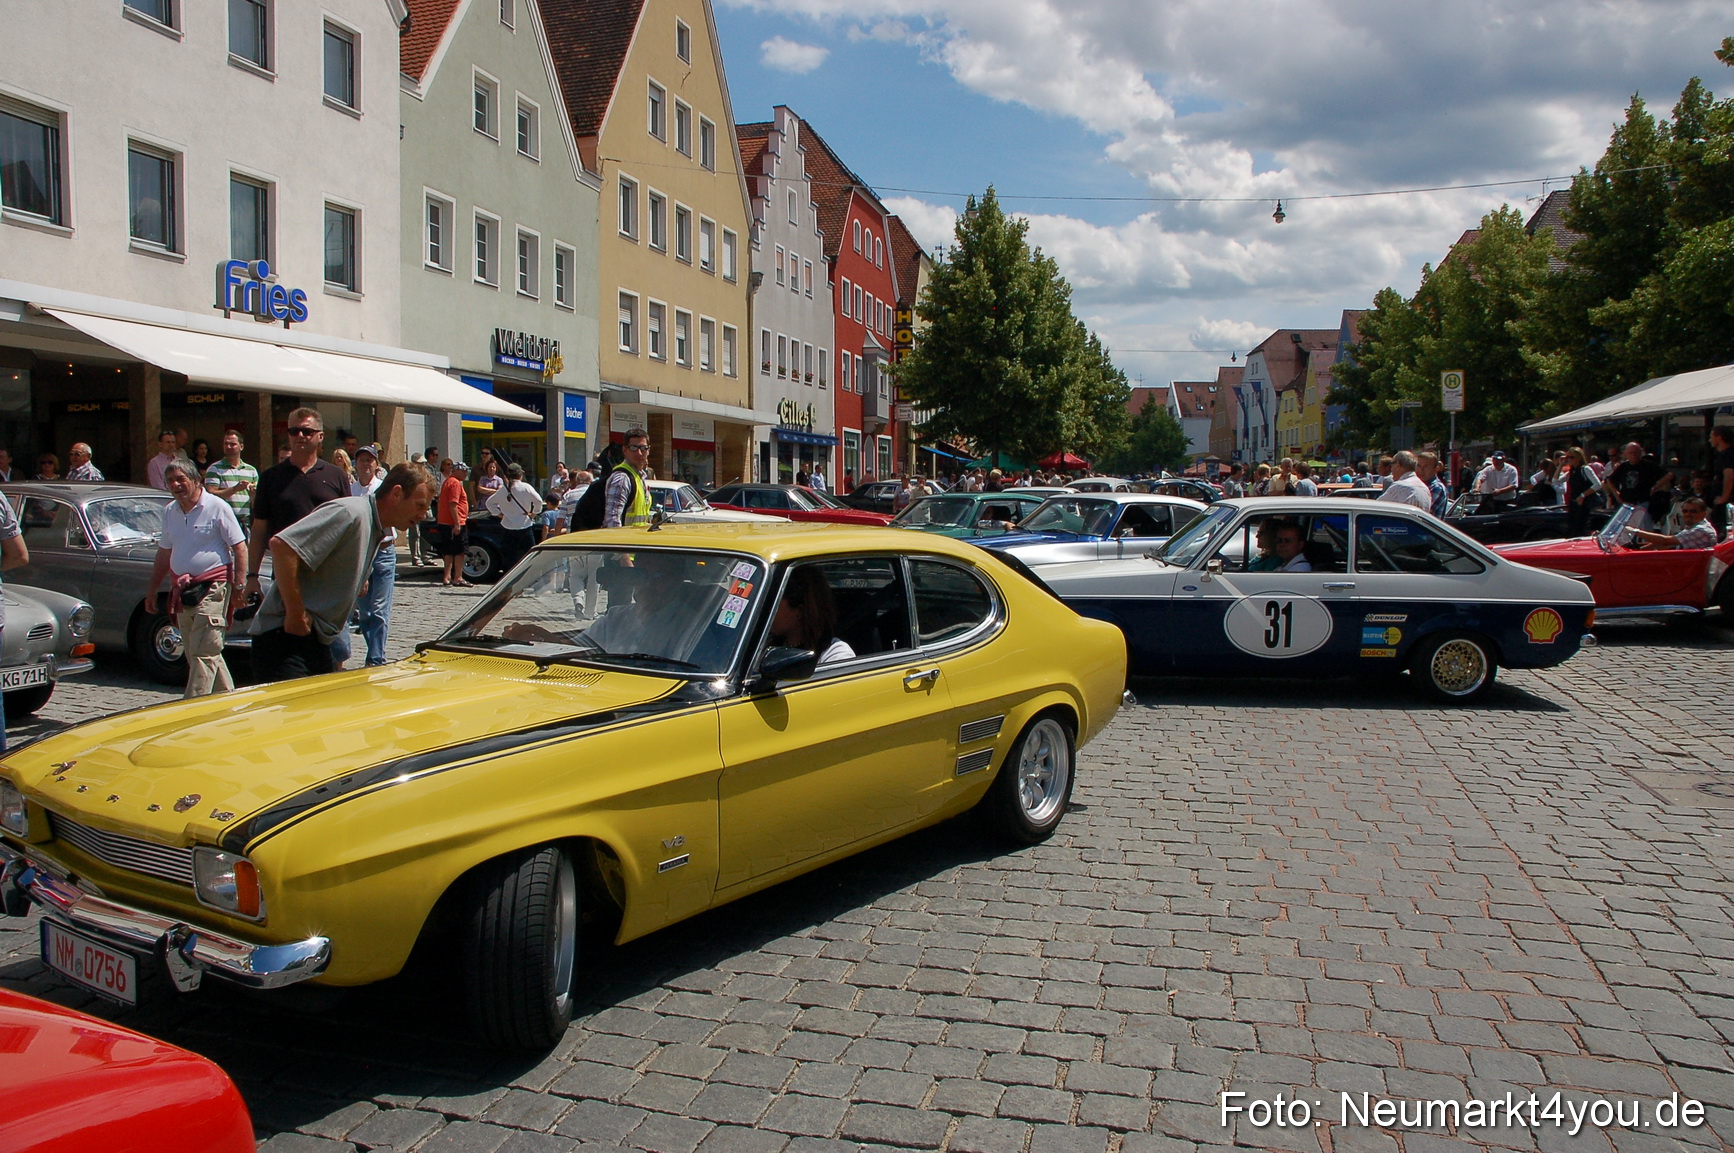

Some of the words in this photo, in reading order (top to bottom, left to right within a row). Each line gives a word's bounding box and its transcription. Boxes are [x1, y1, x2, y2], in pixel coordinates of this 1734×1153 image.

[498, 328, 561, 361] Weltbild
[897, 310, 912, 399] HOTL
[67, 403, 100, 412] SCHUH
[187, 393, 226, 404] SCHUH
[565, 406, 583, 420] Bücher
[1263, 600, 1294, 649] 31
[2, 671, 20, 688] KG
[22, 666, 47, 684] 71H
[662, 834, 687, 849] V8
[56, 932, 75, 972] NM
[84, 945, 127, 993] 0756
